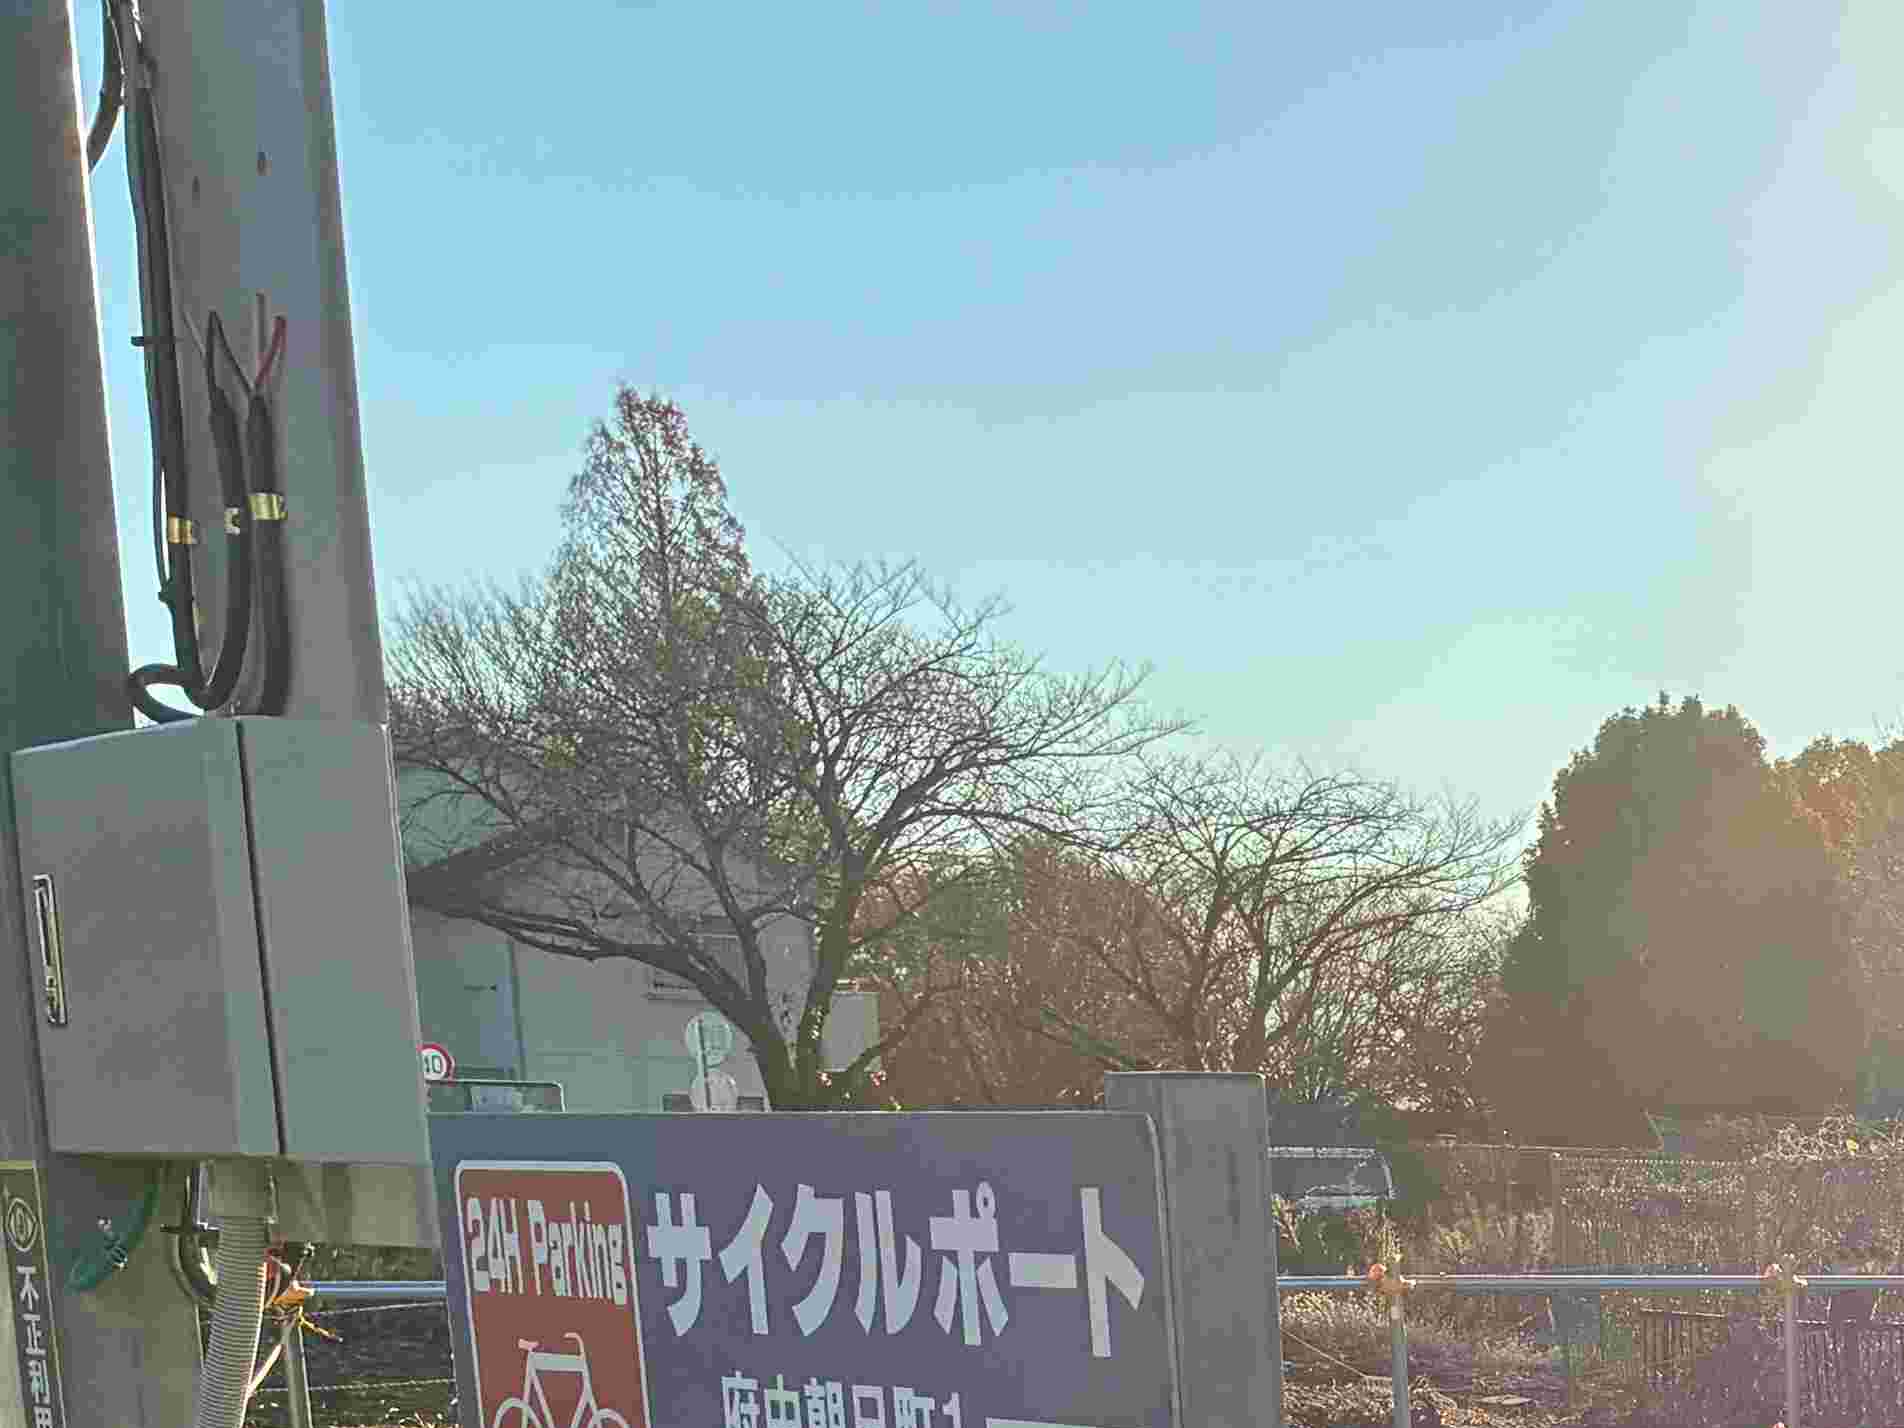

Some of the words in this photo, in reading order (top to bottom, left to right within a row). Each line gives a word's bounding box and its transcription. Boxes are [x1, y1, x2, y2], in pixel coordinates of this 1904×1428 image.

[465, 1197, 524, 1295] 24H
[528, 1199, 628, 1306] Parking
[647, 1180, 1145, 1358] サイクルポート
